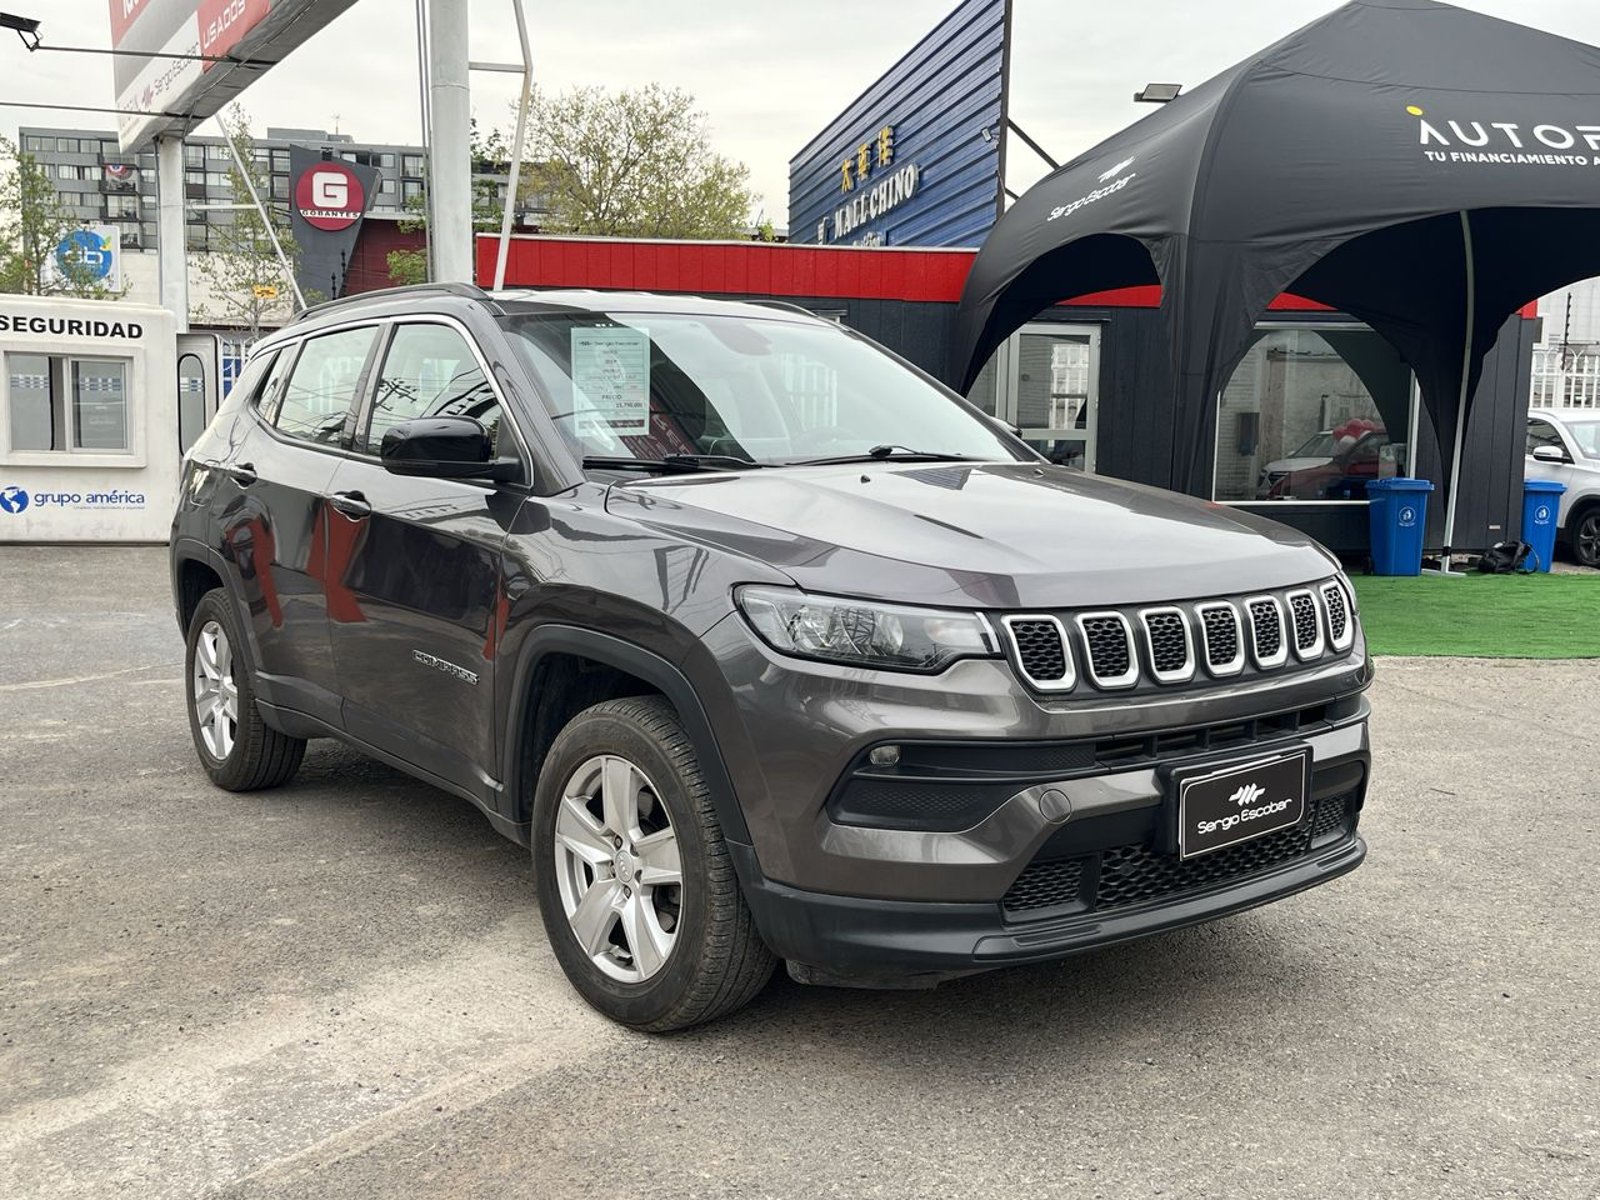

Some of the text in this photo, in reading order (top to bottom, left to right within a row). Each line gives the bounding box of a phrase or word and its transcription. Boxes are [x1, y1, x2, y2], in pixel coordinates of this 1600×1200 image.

[203, 0, 246, 50] USADOS
[1424, 151, 1446, 162] TU
[1450, 152, 1588, 166] FINANCIAMIENTO
[312, 171, 348, 209] G
[870, 163, 920, 219] CHINO
[1047, 173, 1136, 221] Sergo Escobar
[302, 209, 359, 218] GOBANTES
[0, 314, 143, 339] SEGURIDAD
[34, 490, 145, 507] grupo américa
[1197, 797, 1293, 835] Sergo Escobar
